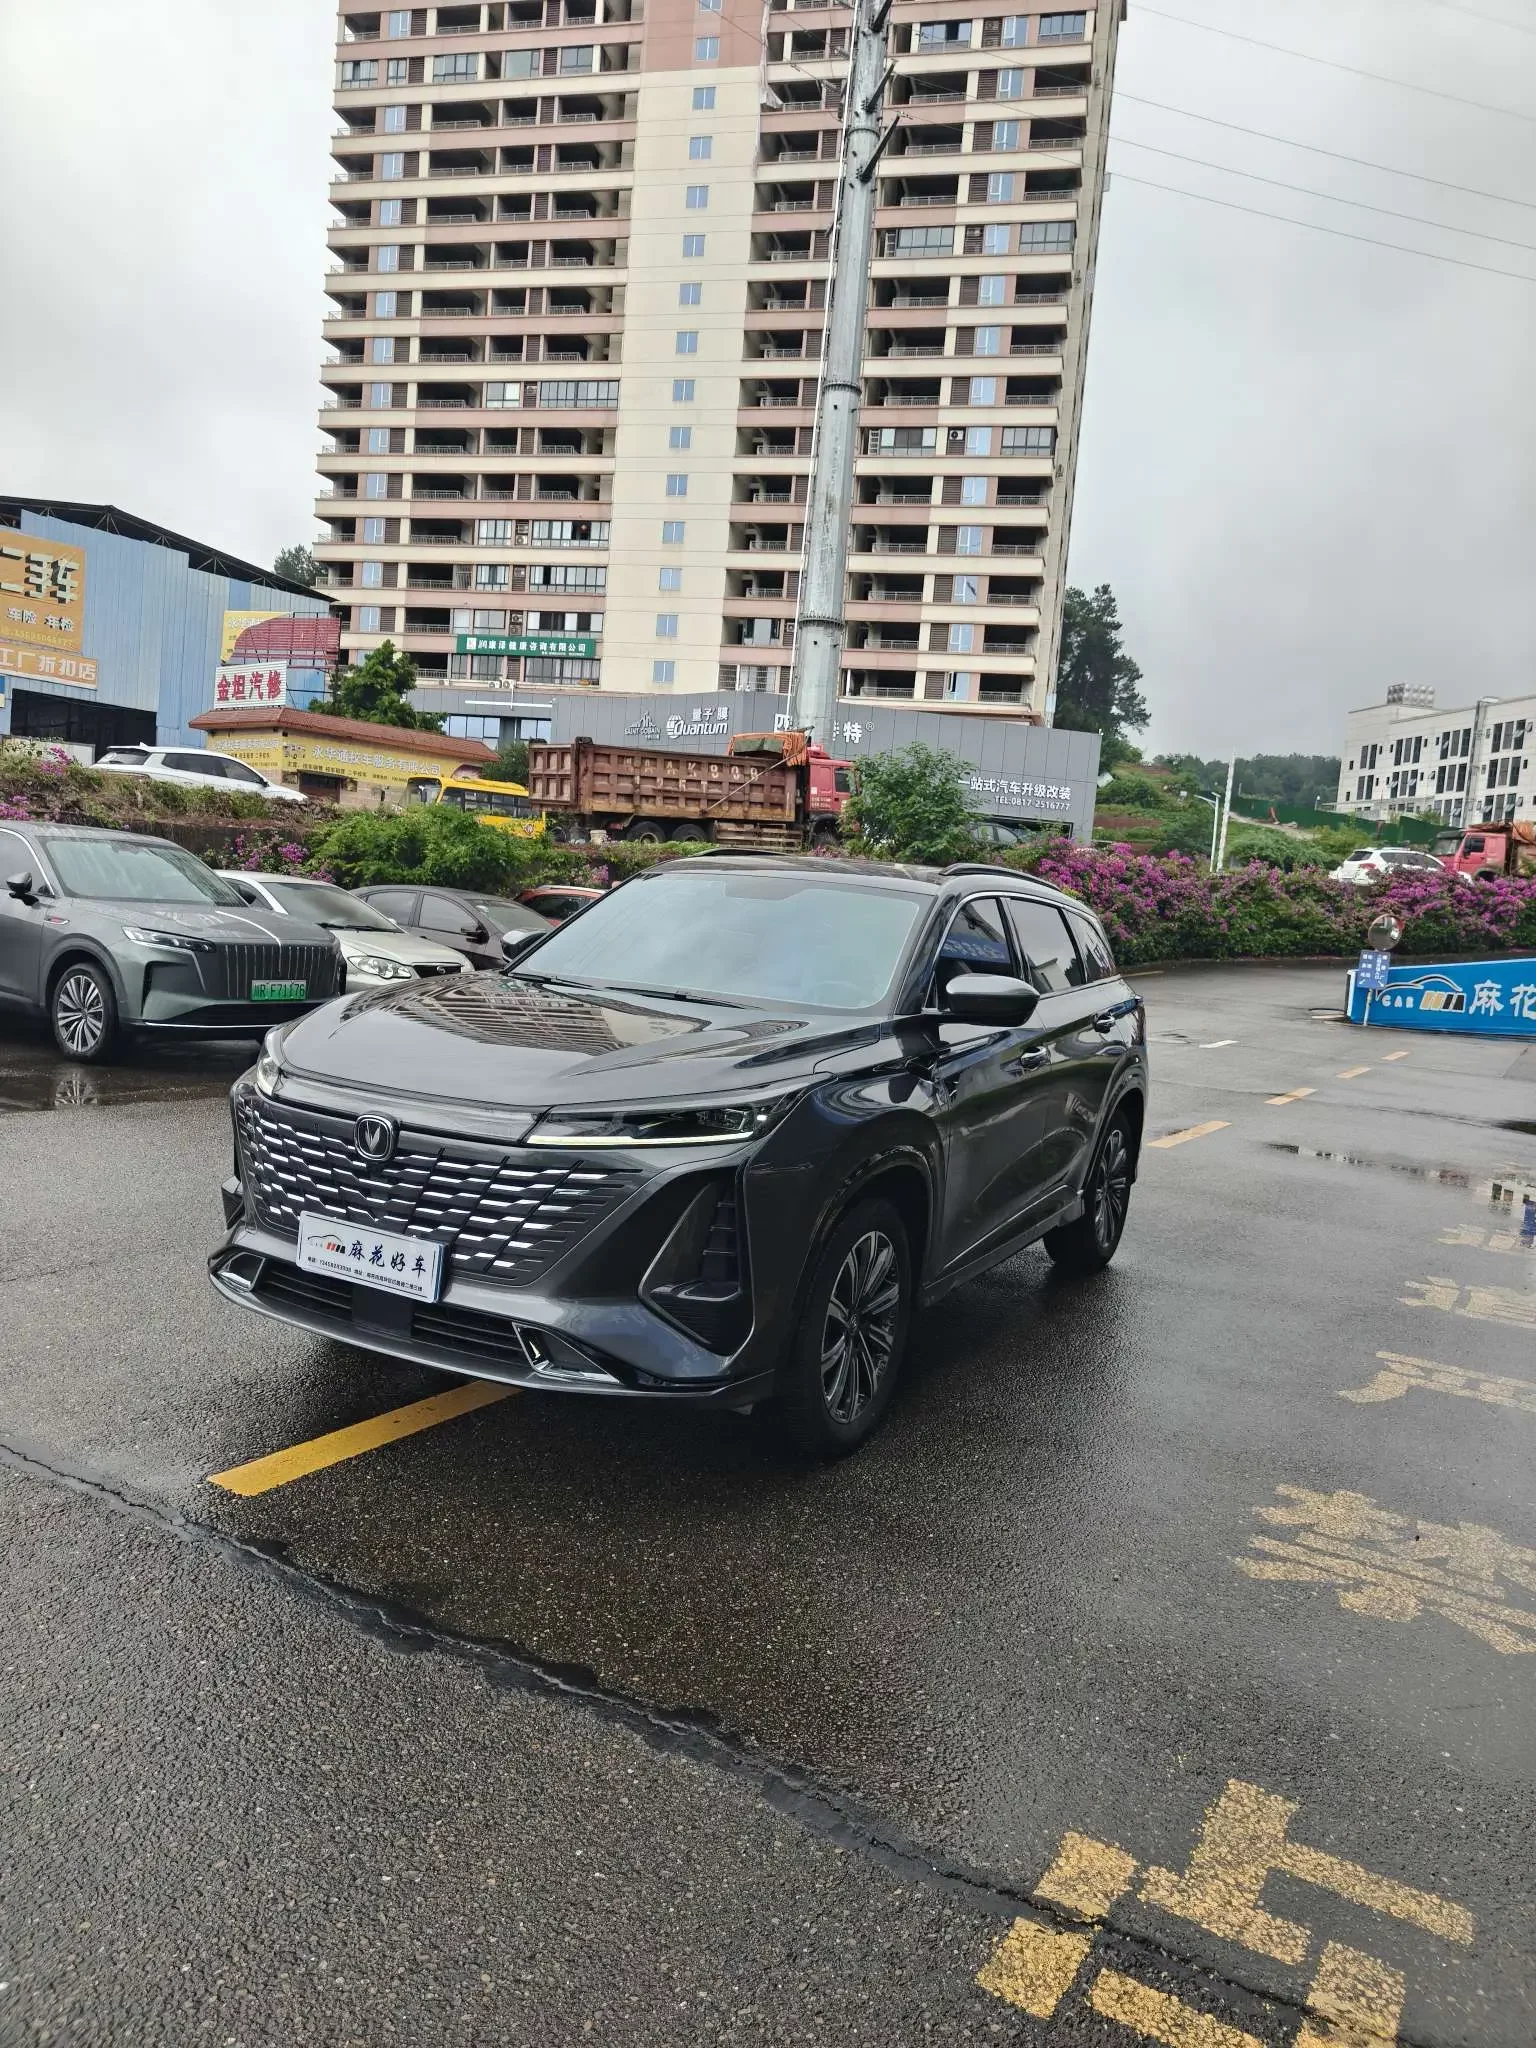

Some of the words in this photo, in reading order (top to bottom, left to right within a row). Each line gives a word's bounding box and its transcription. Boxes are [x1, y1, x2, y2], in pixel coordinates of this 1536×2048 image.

[0, 647, 97, 680] 工厂折扣店
[217, 668, 282, 701] 金坦汽修
[671, 718, 729, 738] Quantum
[958, 776, 1072, 800] 一站式汽车升级改装
[348, 1239, 426, 1278] 麻花好车
